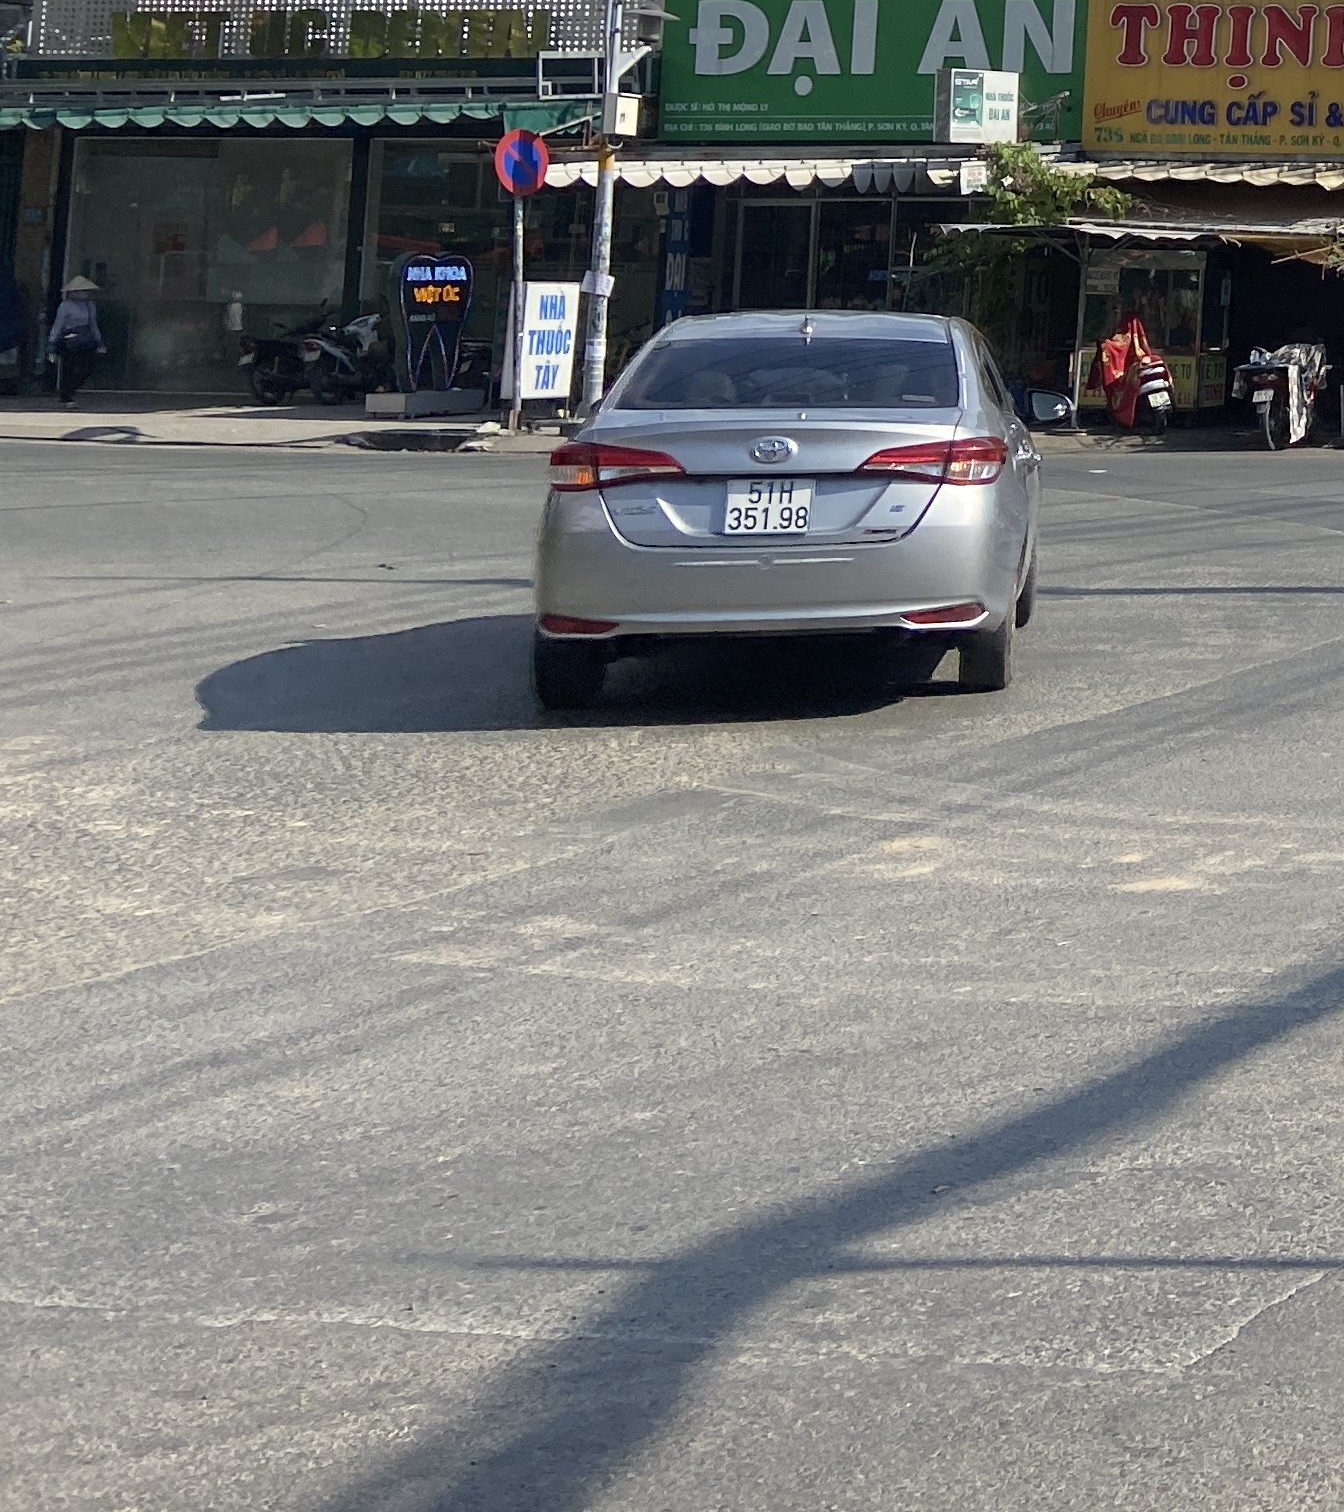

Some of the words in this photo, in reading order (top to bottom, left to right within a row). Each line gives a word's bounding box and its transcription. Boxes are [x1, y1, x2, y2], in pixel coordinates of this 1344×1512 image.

[1145, 98, 1217, 126] CUNG
[1225, 90, 1279, 127] CẤP
[1289, 92, 1318, 127] SỈ
[1325, 102, 1344, 127] &
[539, 290, 566, 320] NHÀ
[528, 324, 572, 356] THUỐC
[534, 359, 560, 390] TÂY
[748, 481, 794, 505] 51H
[727, 505, 809, 531] 351.98
